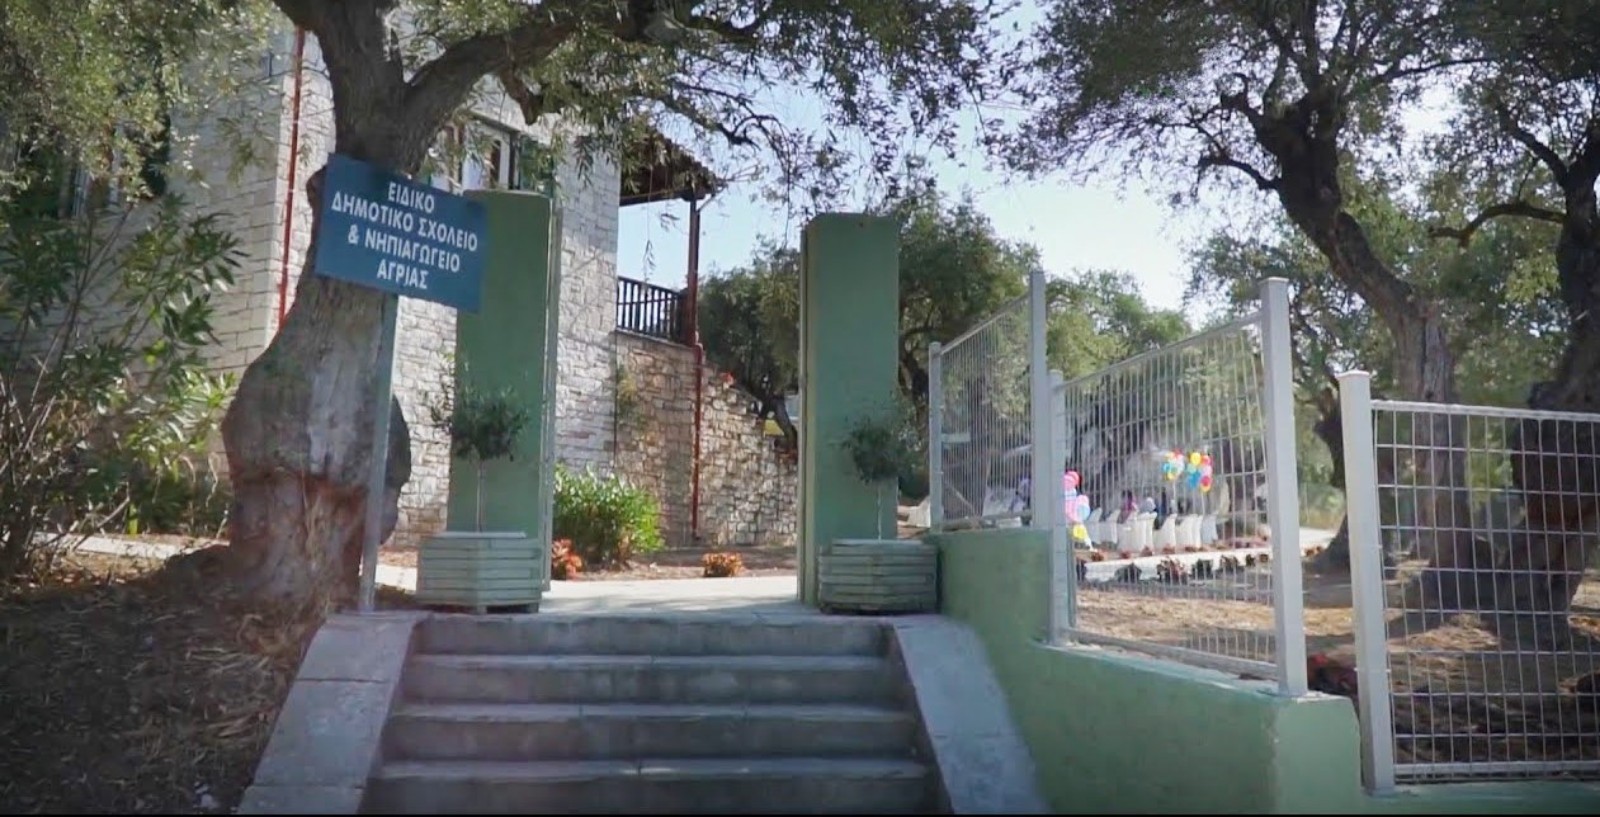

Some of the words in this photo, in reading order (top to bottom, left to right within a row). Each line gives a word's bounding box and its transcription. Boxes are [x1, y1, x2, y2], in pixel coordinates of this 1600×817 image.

[388, 182, 435, 213] ΕΙΔΙΚΟ
[331, 191, 415, 232] ΔΗΜΟΤΙΚΟ
[418, 217, 478, 252] ΣΧΟΛΕΙΟ
[348, 224, 359, 245] &
[365, 228, 460, 273] ΝΗΠΙΑΓΩΓΕΙΟ
[376, 259, 429, 290] ΑΓΡΙΑΣ
